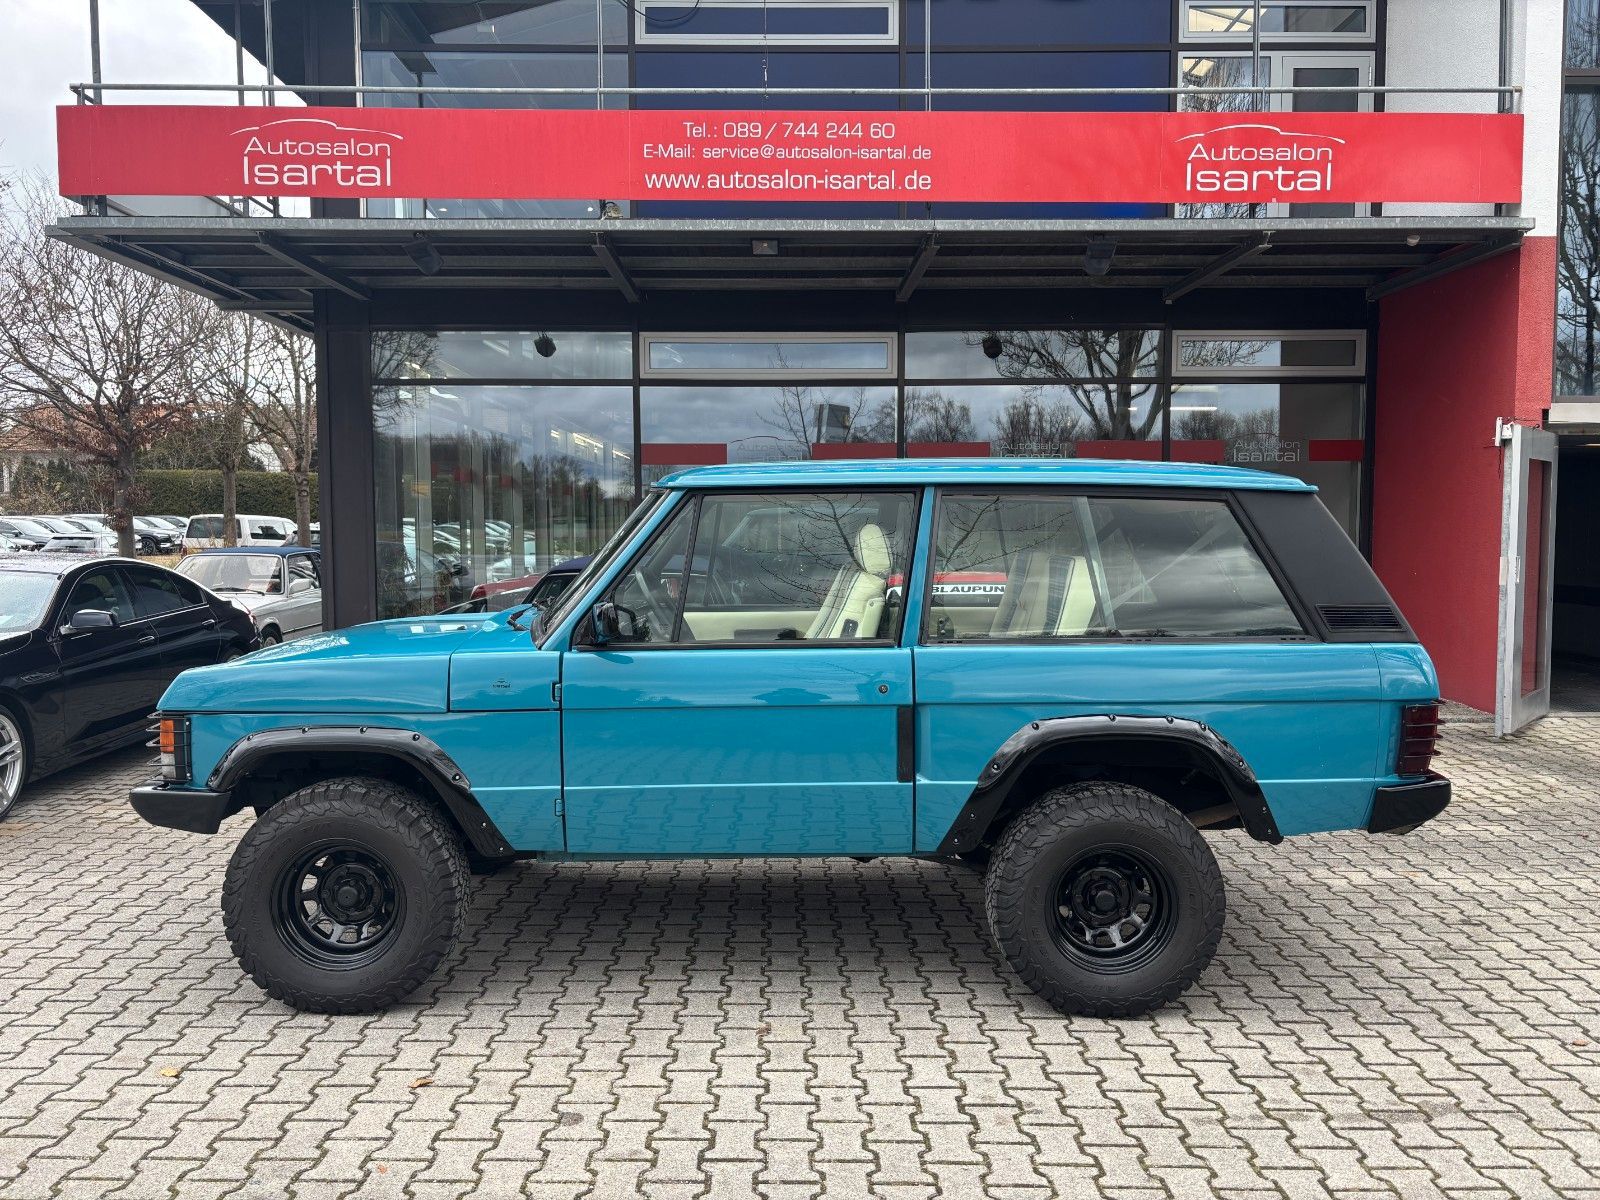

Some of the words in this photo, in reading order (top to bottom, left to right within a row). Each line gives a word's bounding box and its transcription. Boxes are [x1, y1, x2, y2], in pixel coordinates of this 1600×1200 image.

[682, 121, 718, 138] Tel.:
[723, 121, 762, 138] 089
[764, 122, 778, 140] /
[782, 122, 820, 138] 744
[825, 122, 864, 139] 244
[870, 122, 896, 139] 60
[244, 136, 391, 156] Autosalon
[643, 143, 696, 159] E-Mail:
[702, 144, 932, 160] service@autosalon-isartal.de
[1188, 143, 1333, 161] Autosalon
[243, 156, 391, 187] Isartal
[644, 168, 932, 190] www.autosalon-isartal.de
[1186, 162, 1333, 191] Isartal
[1233, 448, 1300, 462] Isartal
